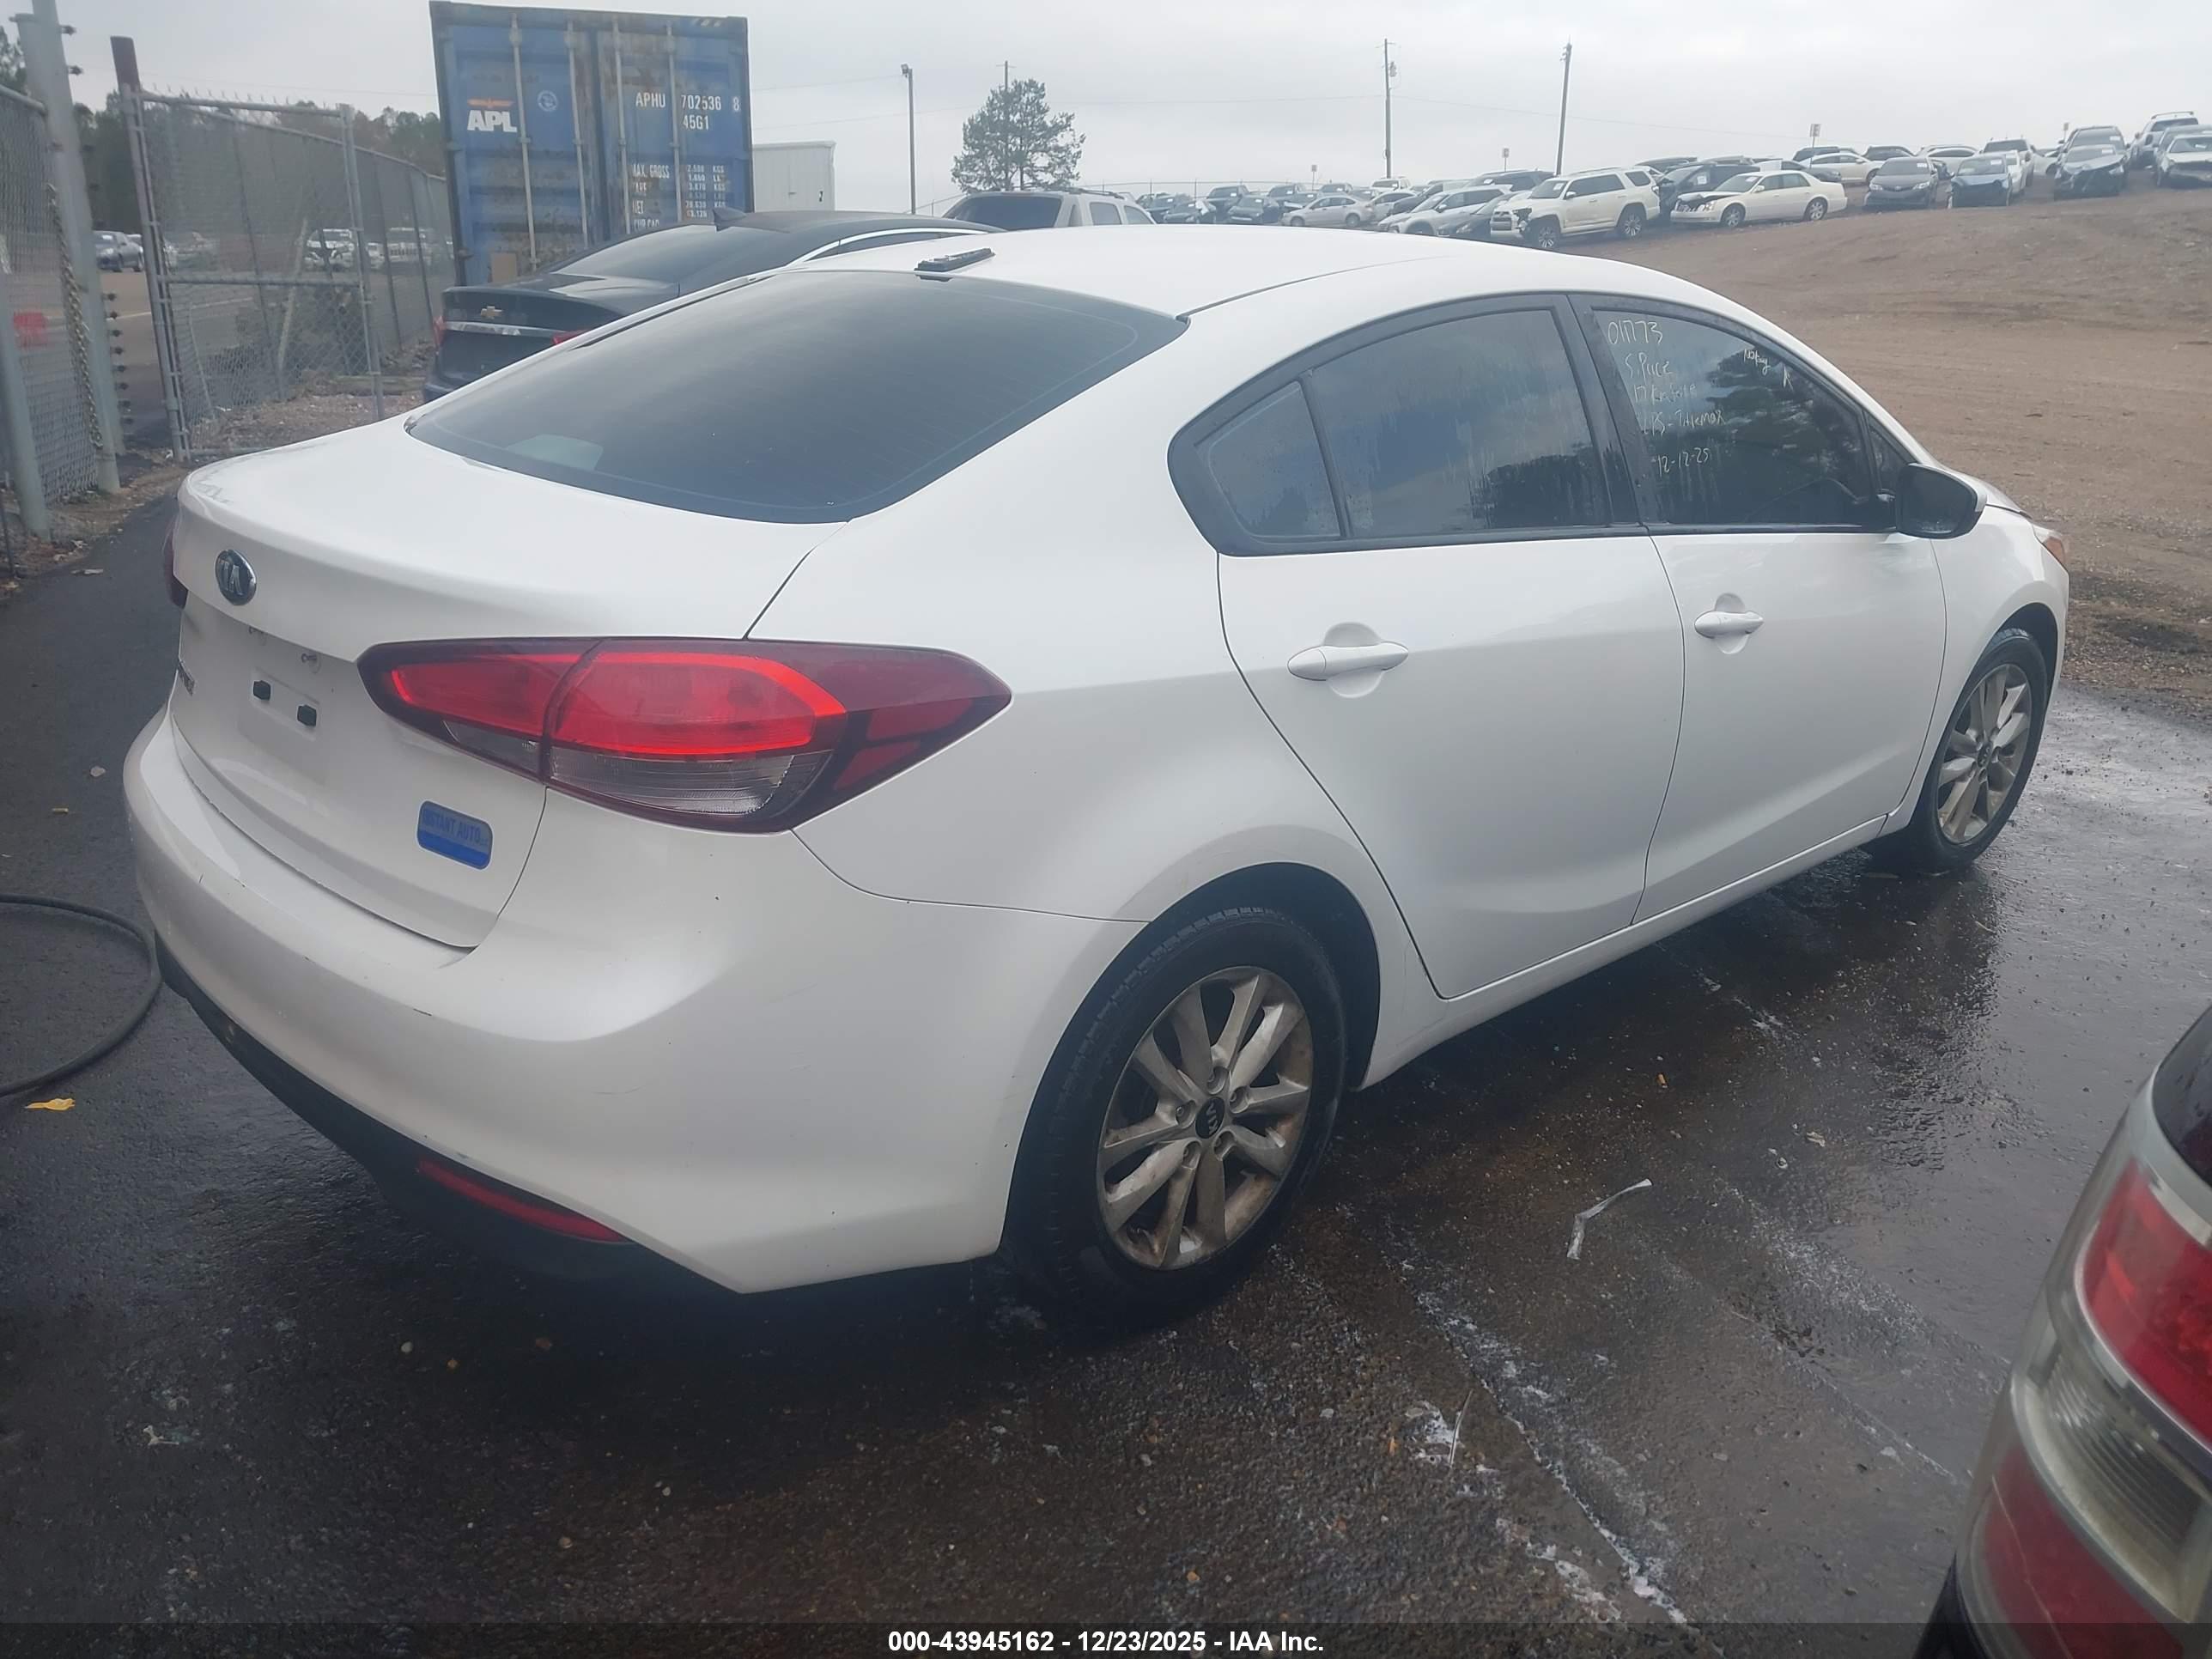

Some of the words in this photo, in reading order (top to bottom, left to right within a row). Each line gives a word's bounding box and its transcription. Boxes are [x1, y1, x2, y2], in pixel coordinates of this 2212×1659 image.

[635, 92, 666, 108] APHU
[681, 94, 721, 110] 702536
[733, 97, 740, 112] 8
[466, 109, 518, 132] APL
[683, 114, 709, 131] 45G1
